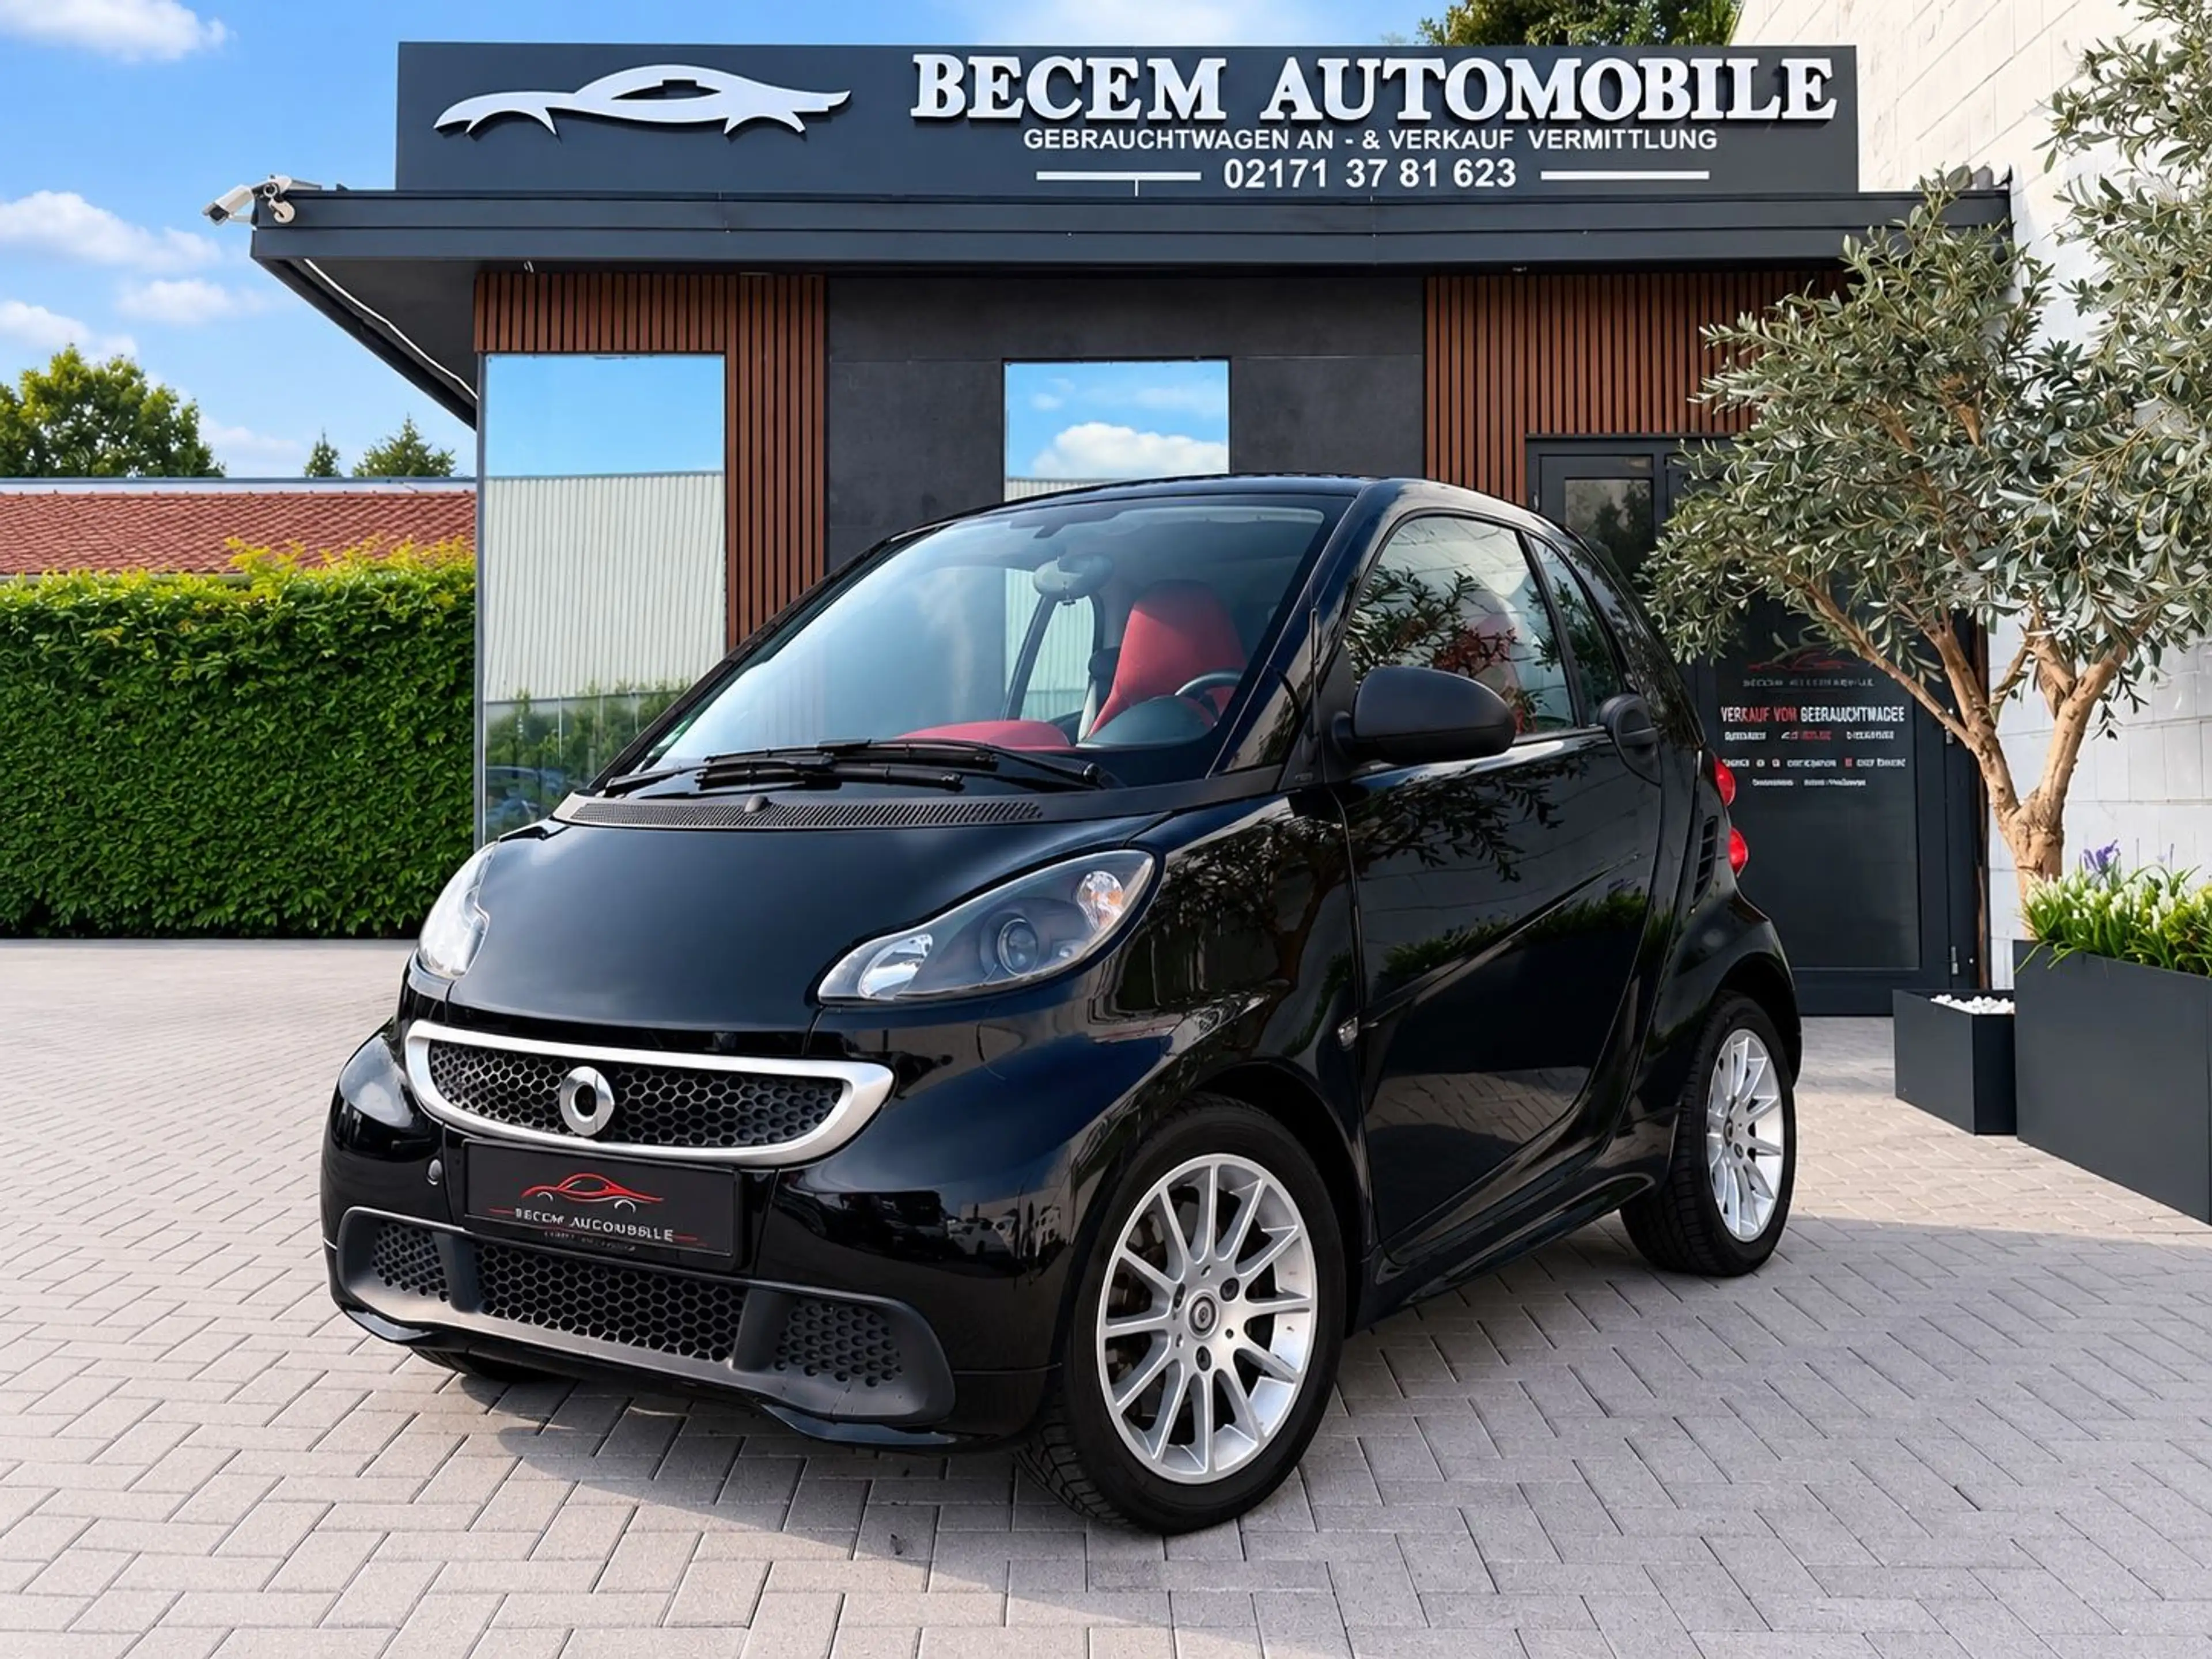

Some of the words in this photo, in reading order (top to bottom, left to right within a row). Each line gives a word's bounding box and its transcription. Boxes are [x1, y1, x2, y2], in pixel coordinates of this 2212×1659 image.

[910, 54, 1226, 120] BECEM
[1260, 55, 1837, 123] AUTOMOBILE
[1024, 128, 1289, 150] GEBRAUCHTWAGEN
[1297, 130, 1334, 150] AN
[1362, 130, 1381, 150] &
[1388, 129, 1514, 150] VERKAUF
[1528, 129, 1717, 150] VERMITTLUNG
[1224, 158, 1325, 189] 02171
[1346, 158, 1388, 188] 37
[1399, 158, 1437, 188] 81
[1453, 158, 1516, 188] 623
[1721, 706, 1770, 722] VERKAUF
